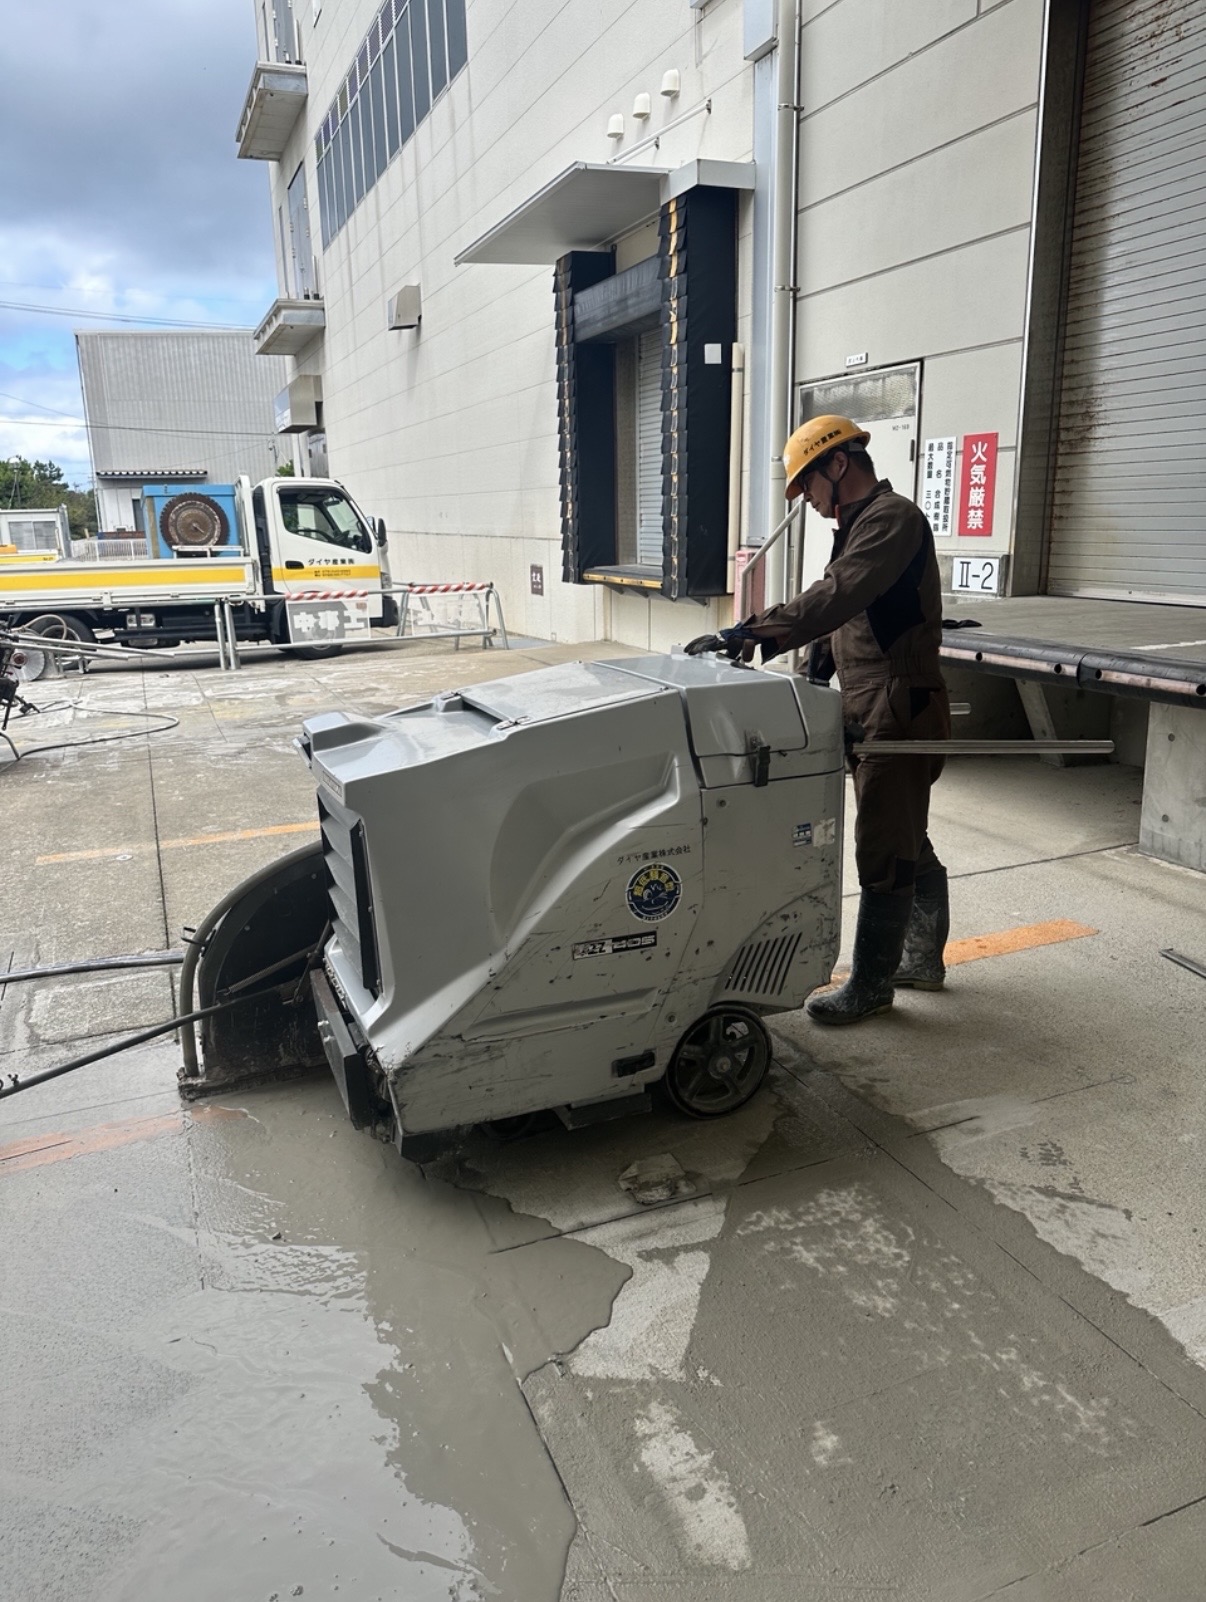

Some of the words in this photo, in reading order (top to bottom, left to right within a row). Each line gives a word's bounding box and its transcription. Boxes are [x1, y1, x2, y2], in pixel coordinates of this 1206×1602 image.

[966, 441, 989, 530] 火気厳禁
[617, 844, 691, 866] ダイヤ産業株式会社
